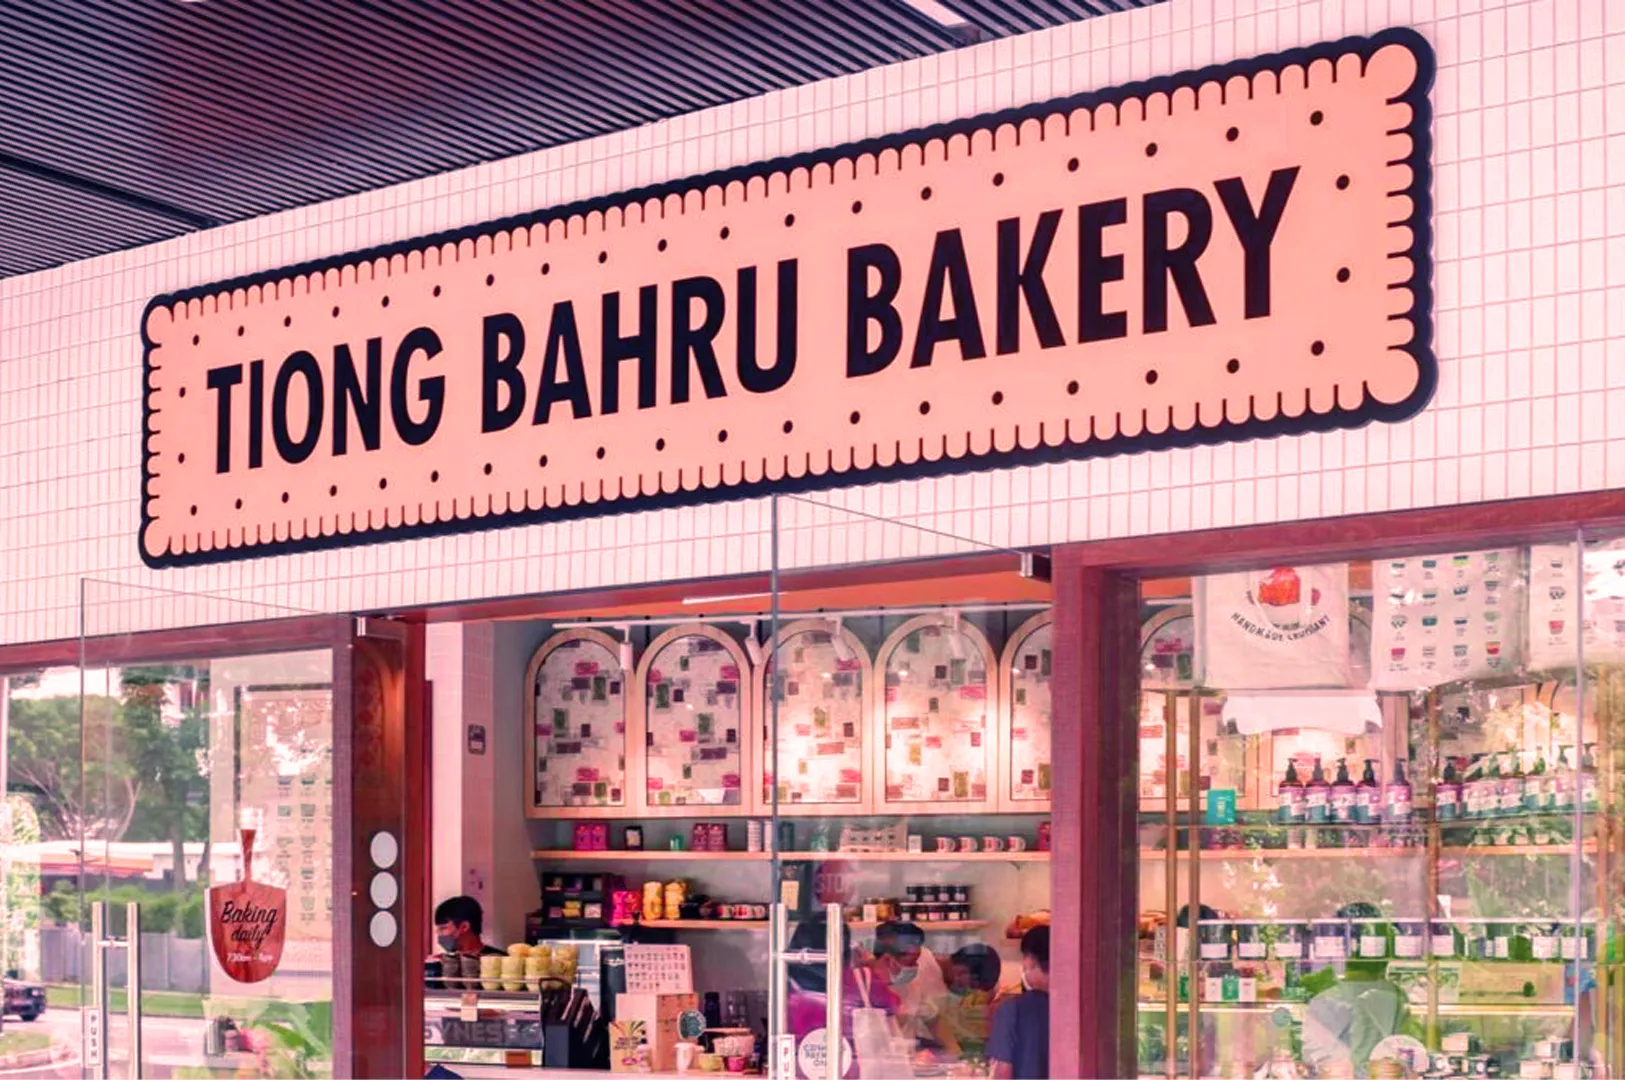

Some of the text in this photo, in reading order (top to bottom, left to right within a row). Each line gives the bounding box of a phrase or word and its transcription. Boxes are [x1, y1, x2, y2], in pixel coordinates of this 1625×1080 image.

[206, 165, 1302, 474] TIONG BAHRU BAKERY
[220, 900, 278, 936] Baking
[230, 925, 267, 950] daily
